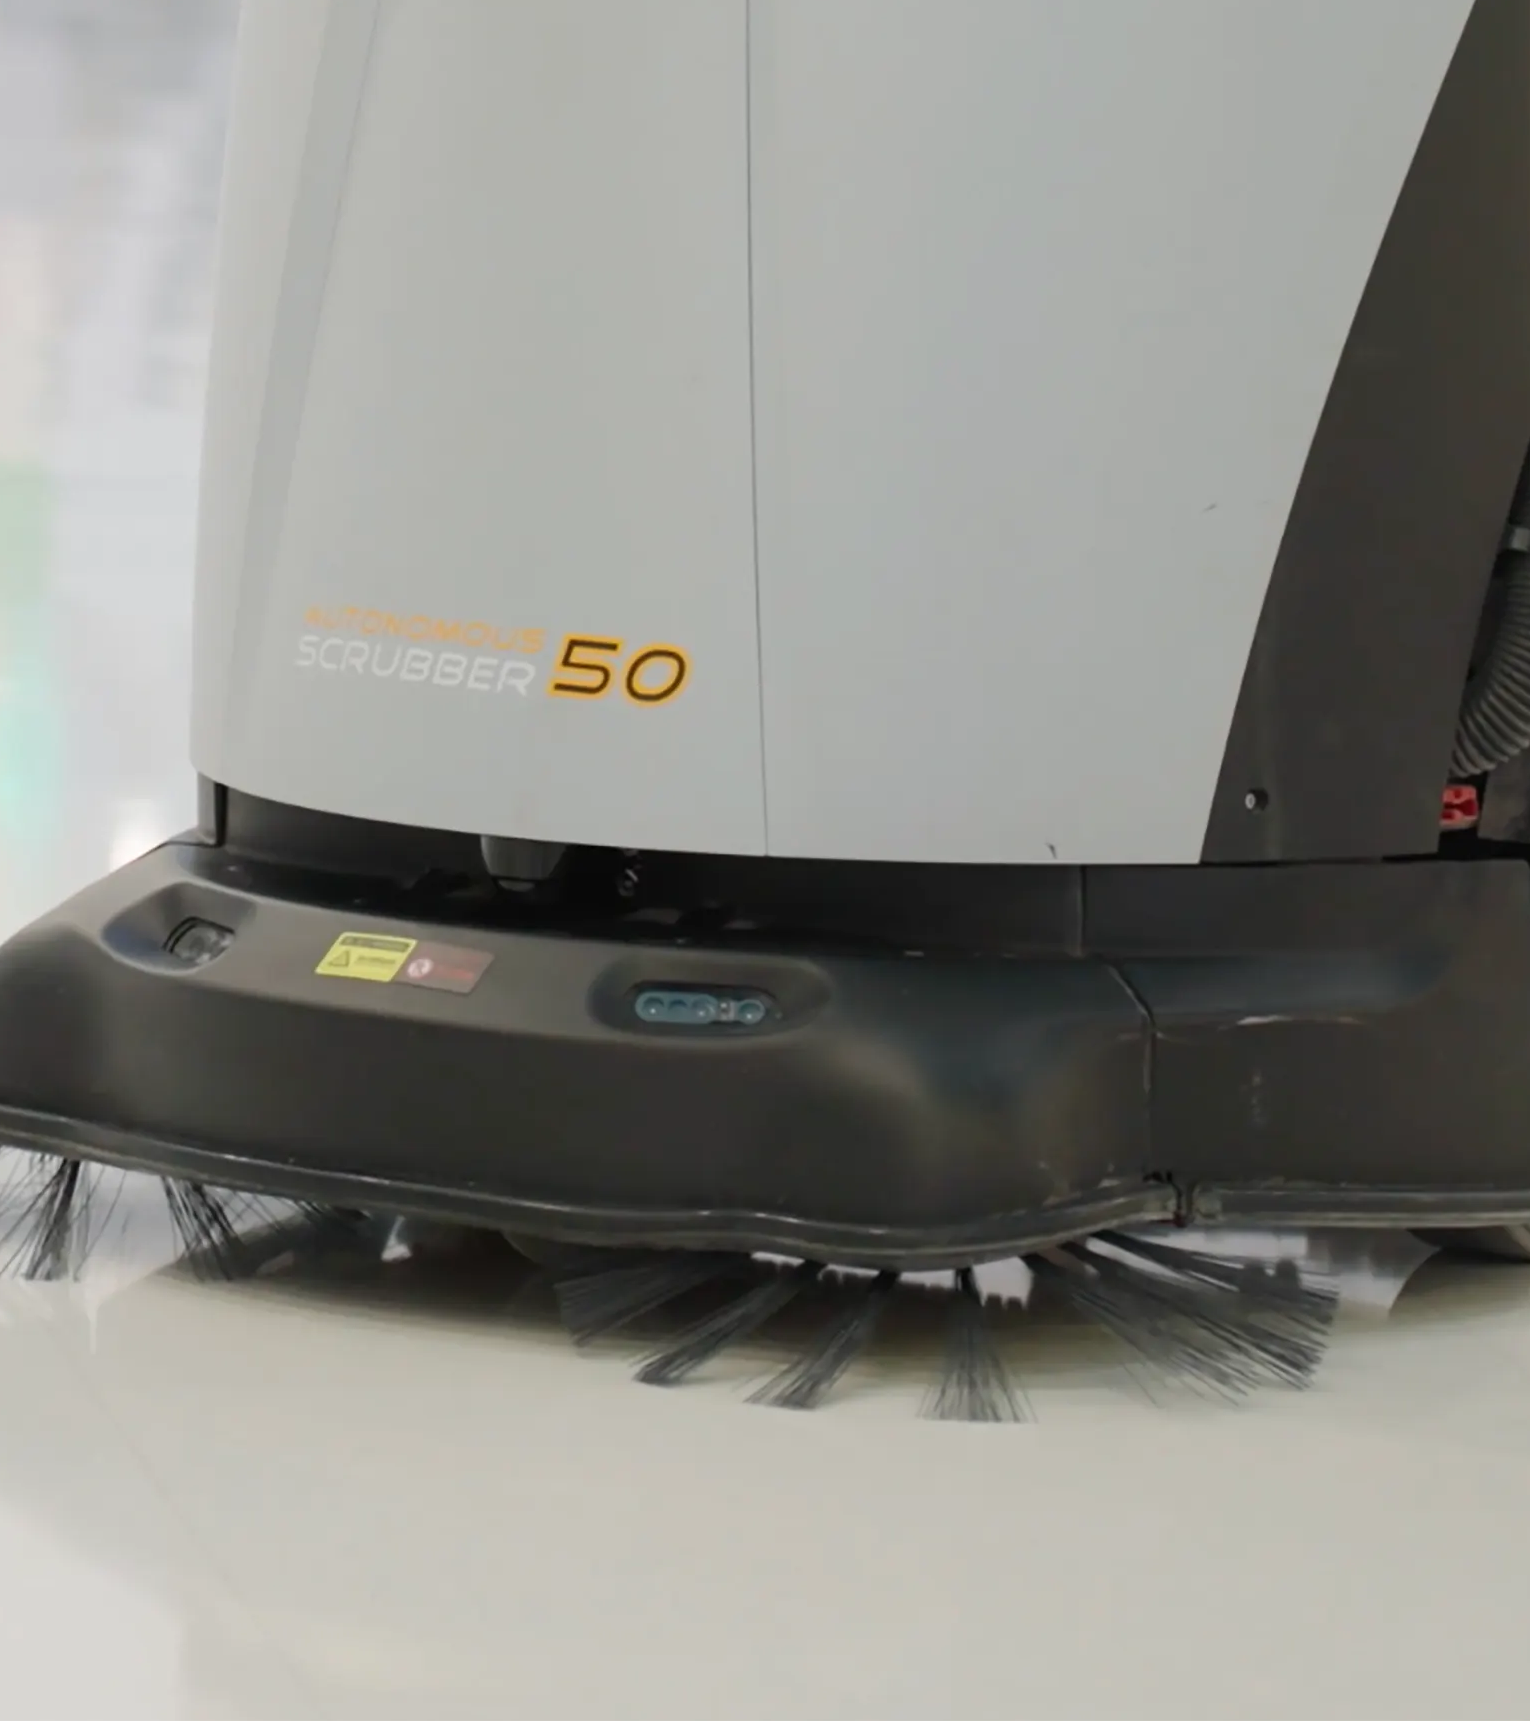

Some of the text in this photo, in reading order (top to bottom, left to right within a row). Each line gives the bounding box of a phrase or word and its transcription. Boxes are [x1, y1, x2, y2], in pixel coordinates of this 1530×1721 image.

[304, 605, 548, 655] AUTONOMOUS
[293, 633, 693, 709] SCRUBBER 50
